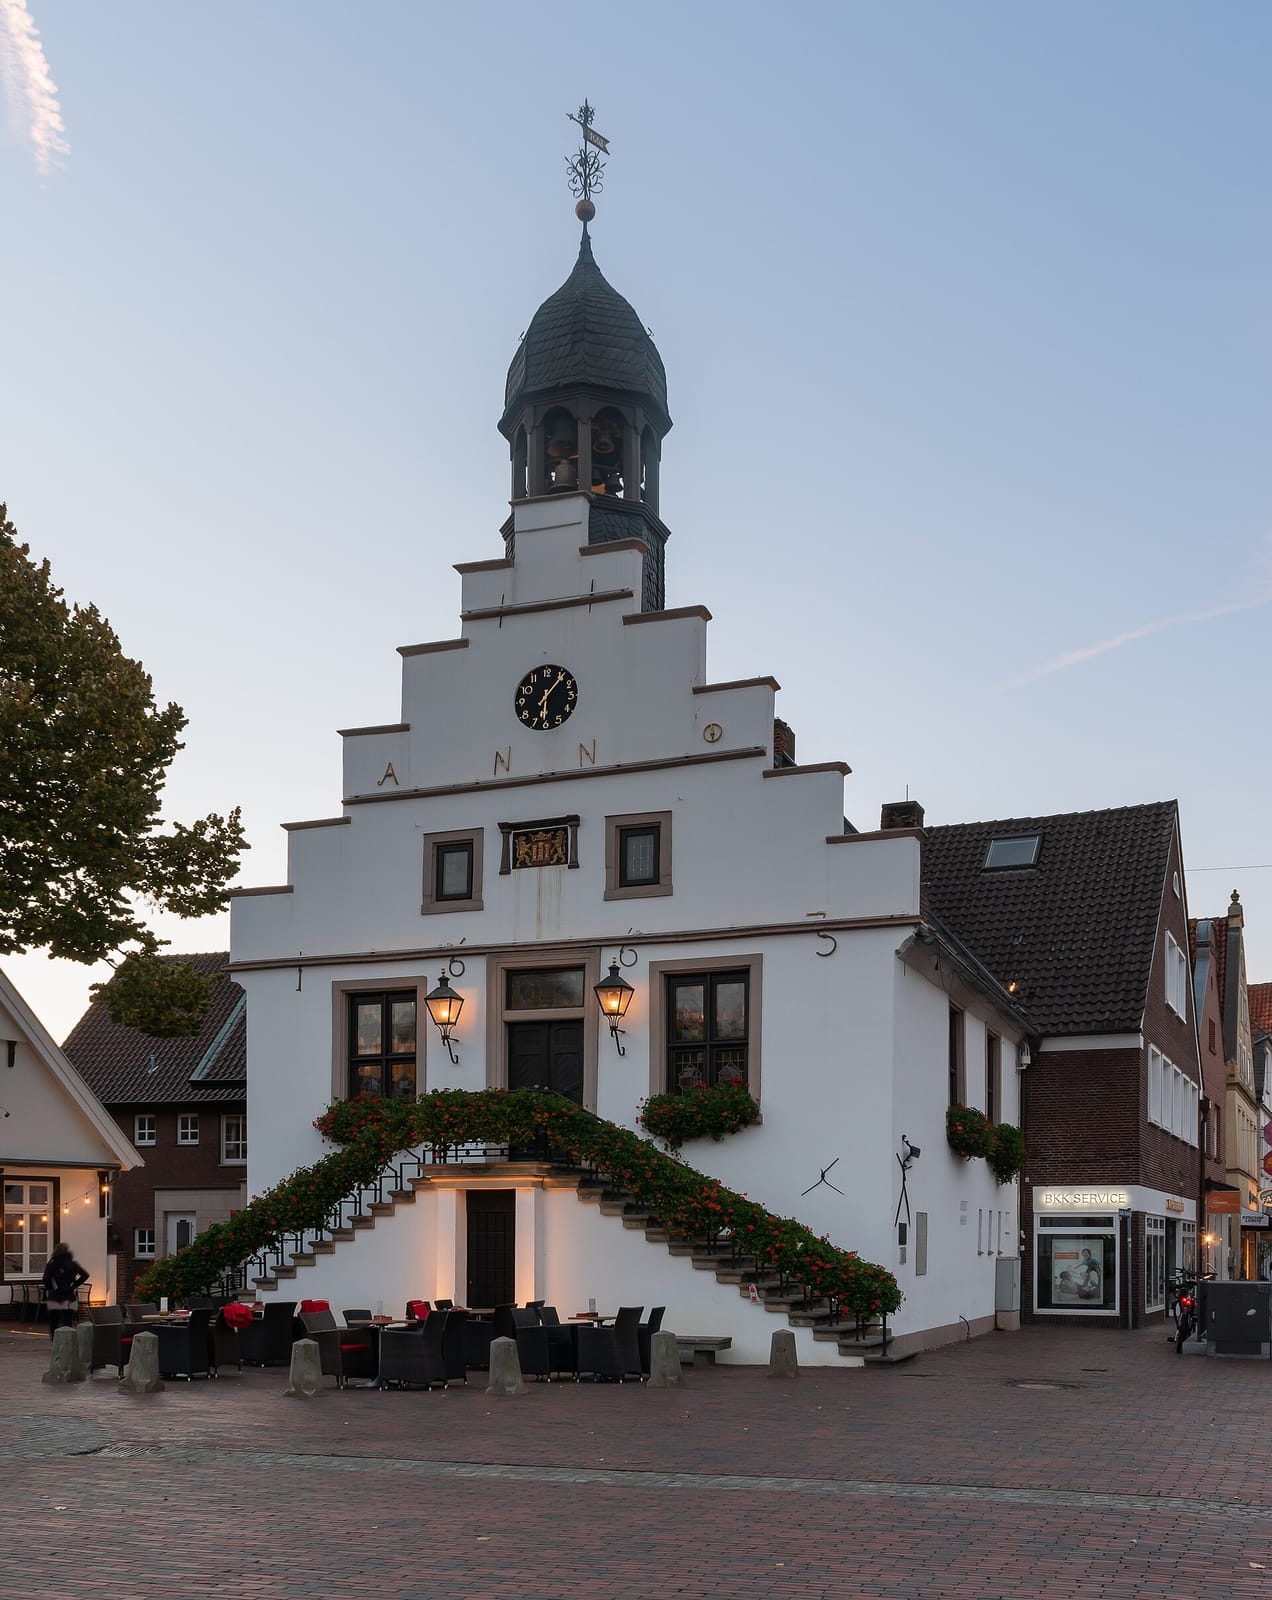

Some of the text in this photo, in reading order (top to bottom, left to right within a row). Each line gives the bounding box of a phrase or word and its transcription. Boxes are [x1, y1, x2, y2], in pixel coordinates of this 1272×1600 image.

[531, 673, 537, 683] 11
[566, 680, 572, 689] 2
[522, 685, 533, 695] 10
[568, 691, 575, 700] 3
[518, 697, 525, 707] 9
[564, 704, 570, 713] 4
[521, 710, 529, 719] 8
[532, 717, 538, 727] 7
[555, 715, 562, 724] 5
[543, 720, 549, 729] 6
[1045, 1193, 1126, 1204] BKK SERVICE
